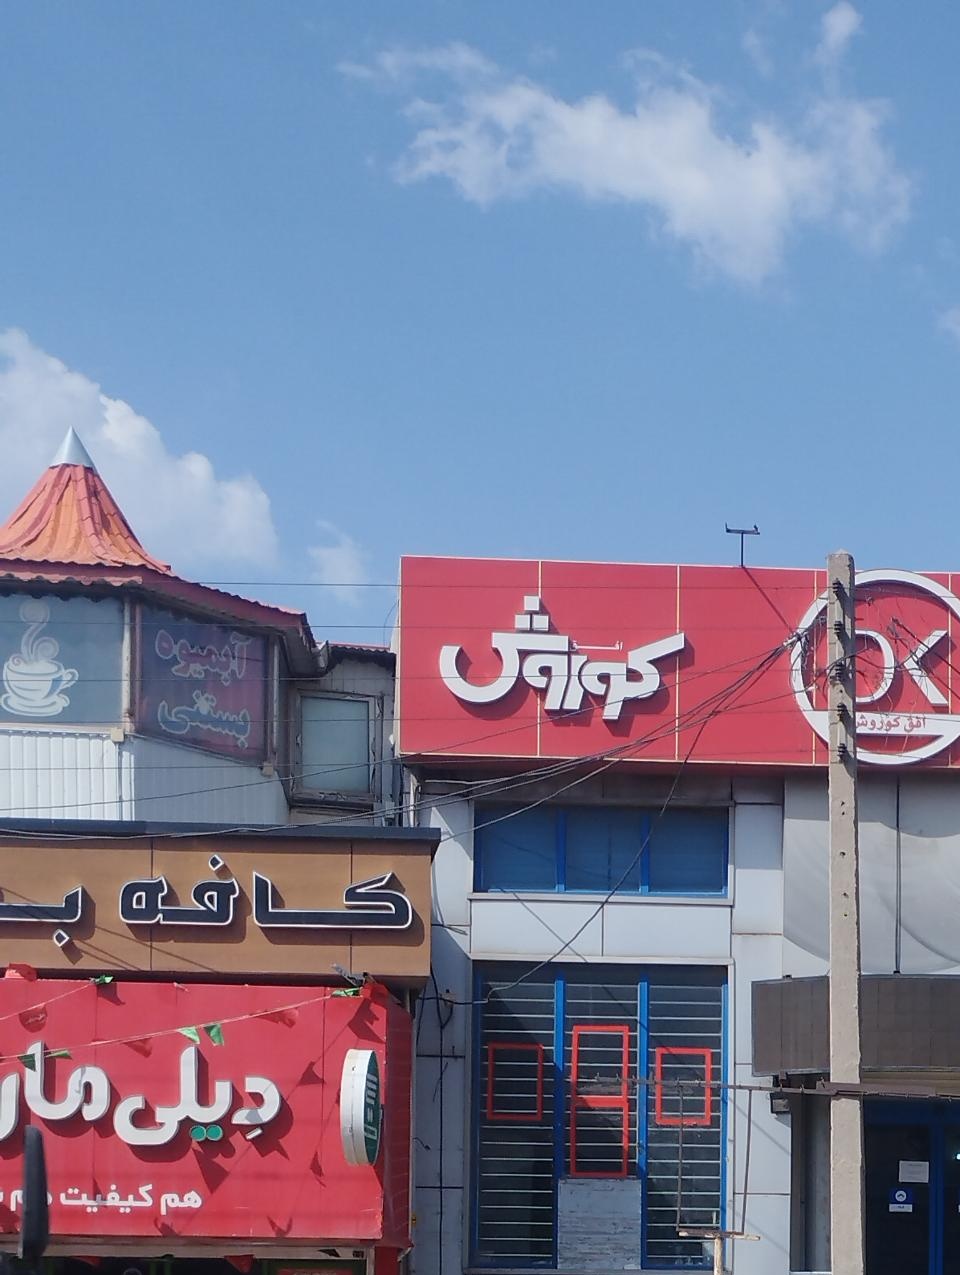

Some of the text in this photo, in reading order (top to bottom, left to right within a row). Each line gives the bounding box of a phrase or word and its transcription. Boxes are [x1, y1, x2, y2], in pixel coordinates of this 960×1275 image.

[438, 595, 685, 721] کوروش
[903, 715, 927, 733] افق
[119, 854, 412, 929] کافه
[10, 1184, 202, 1216] هم کیفیت م
